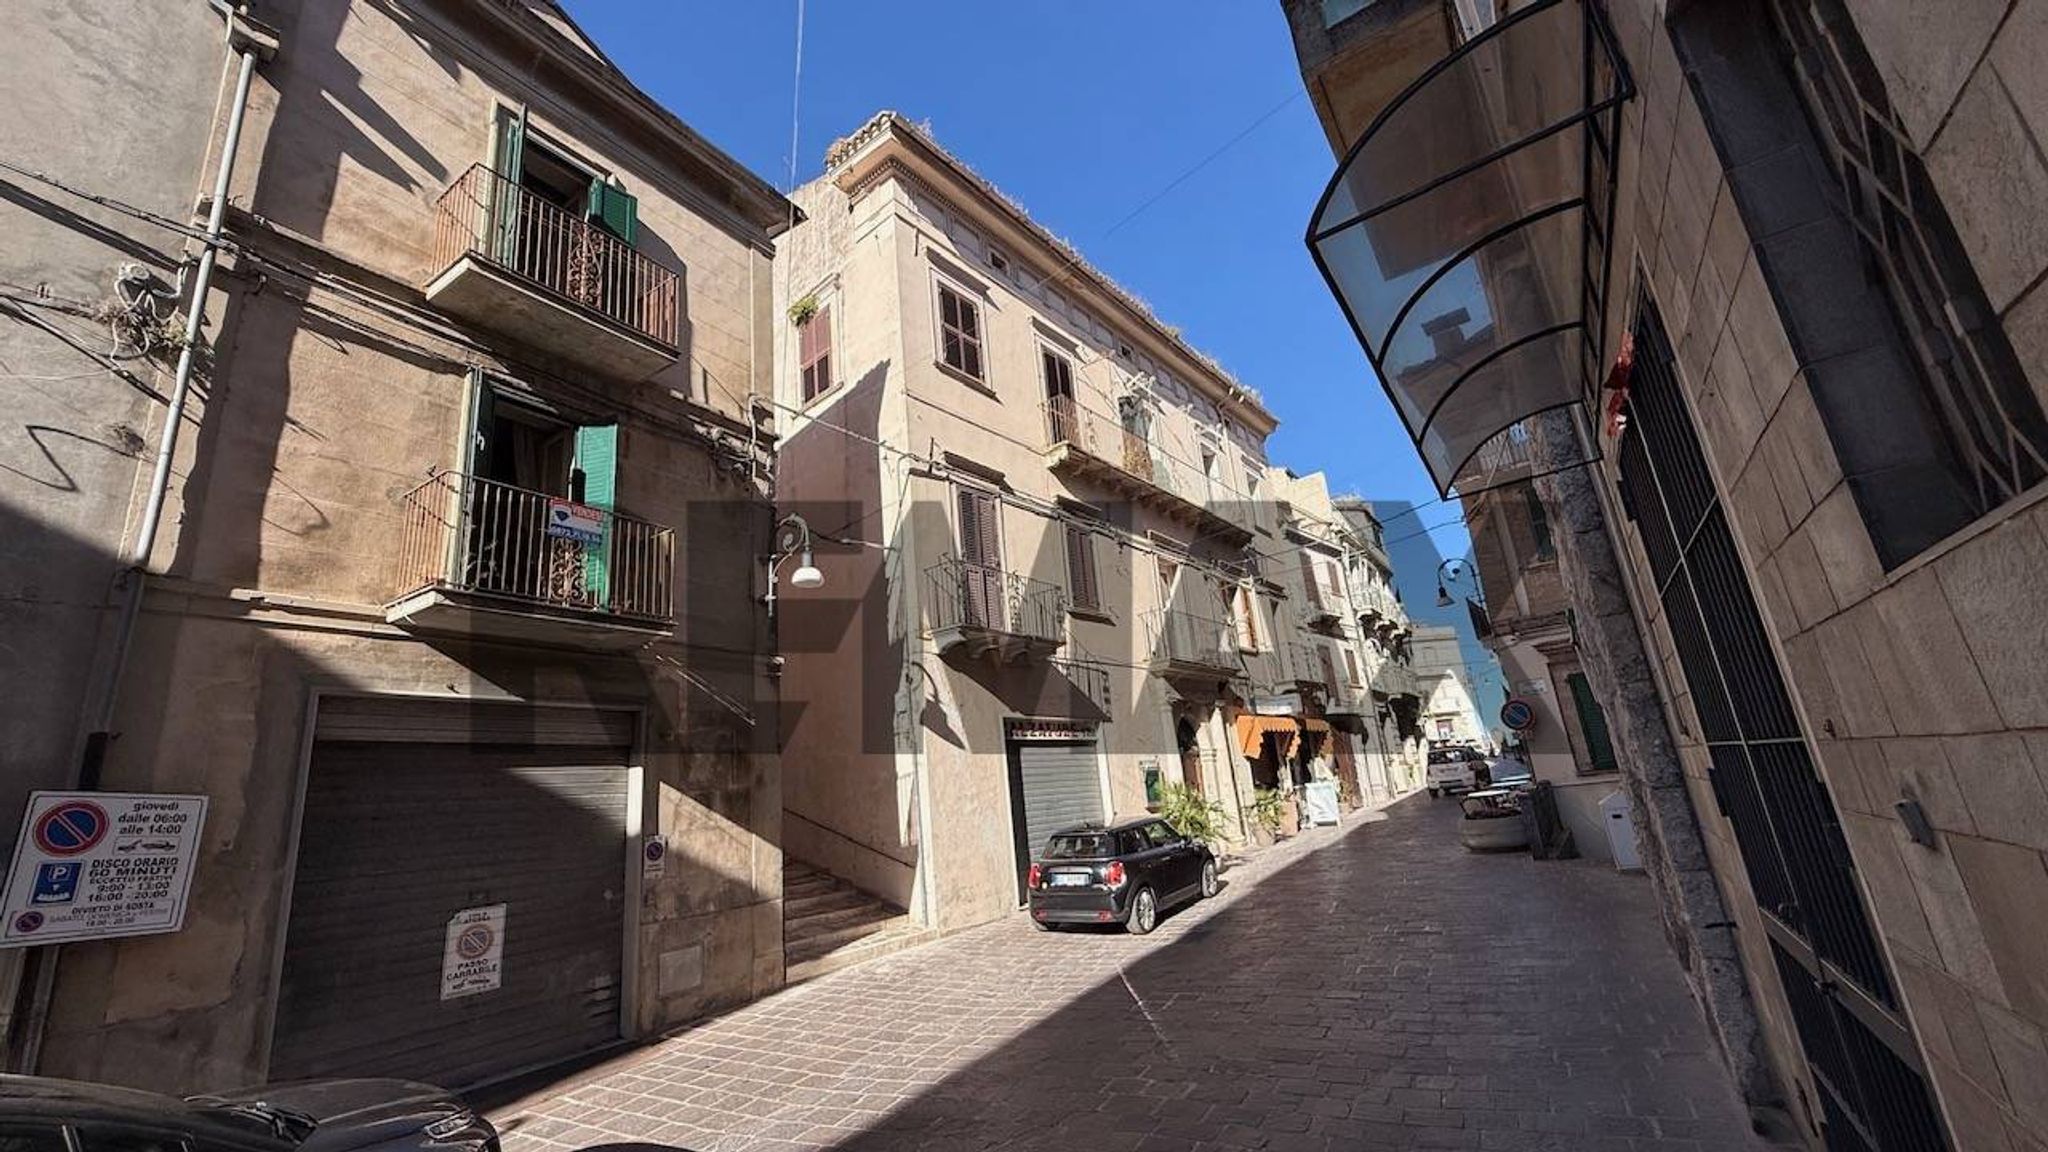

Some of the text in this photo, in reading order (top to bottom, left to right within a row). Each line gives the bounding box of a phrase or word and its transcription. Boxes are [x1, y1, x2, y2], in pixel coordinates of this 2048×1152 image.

[118, 813, 187, 823] dalle 06:00
[119, 824, 182, 834] alle 14:00
[92, 857, 179, 868] DISCO ORARIO
[53, 867, 67, 880] P
[115, 867, 177, 876] MINUTI
[458, 959, 489, 970] PASSO
[446, 964, 498, 980] CARRABILE
